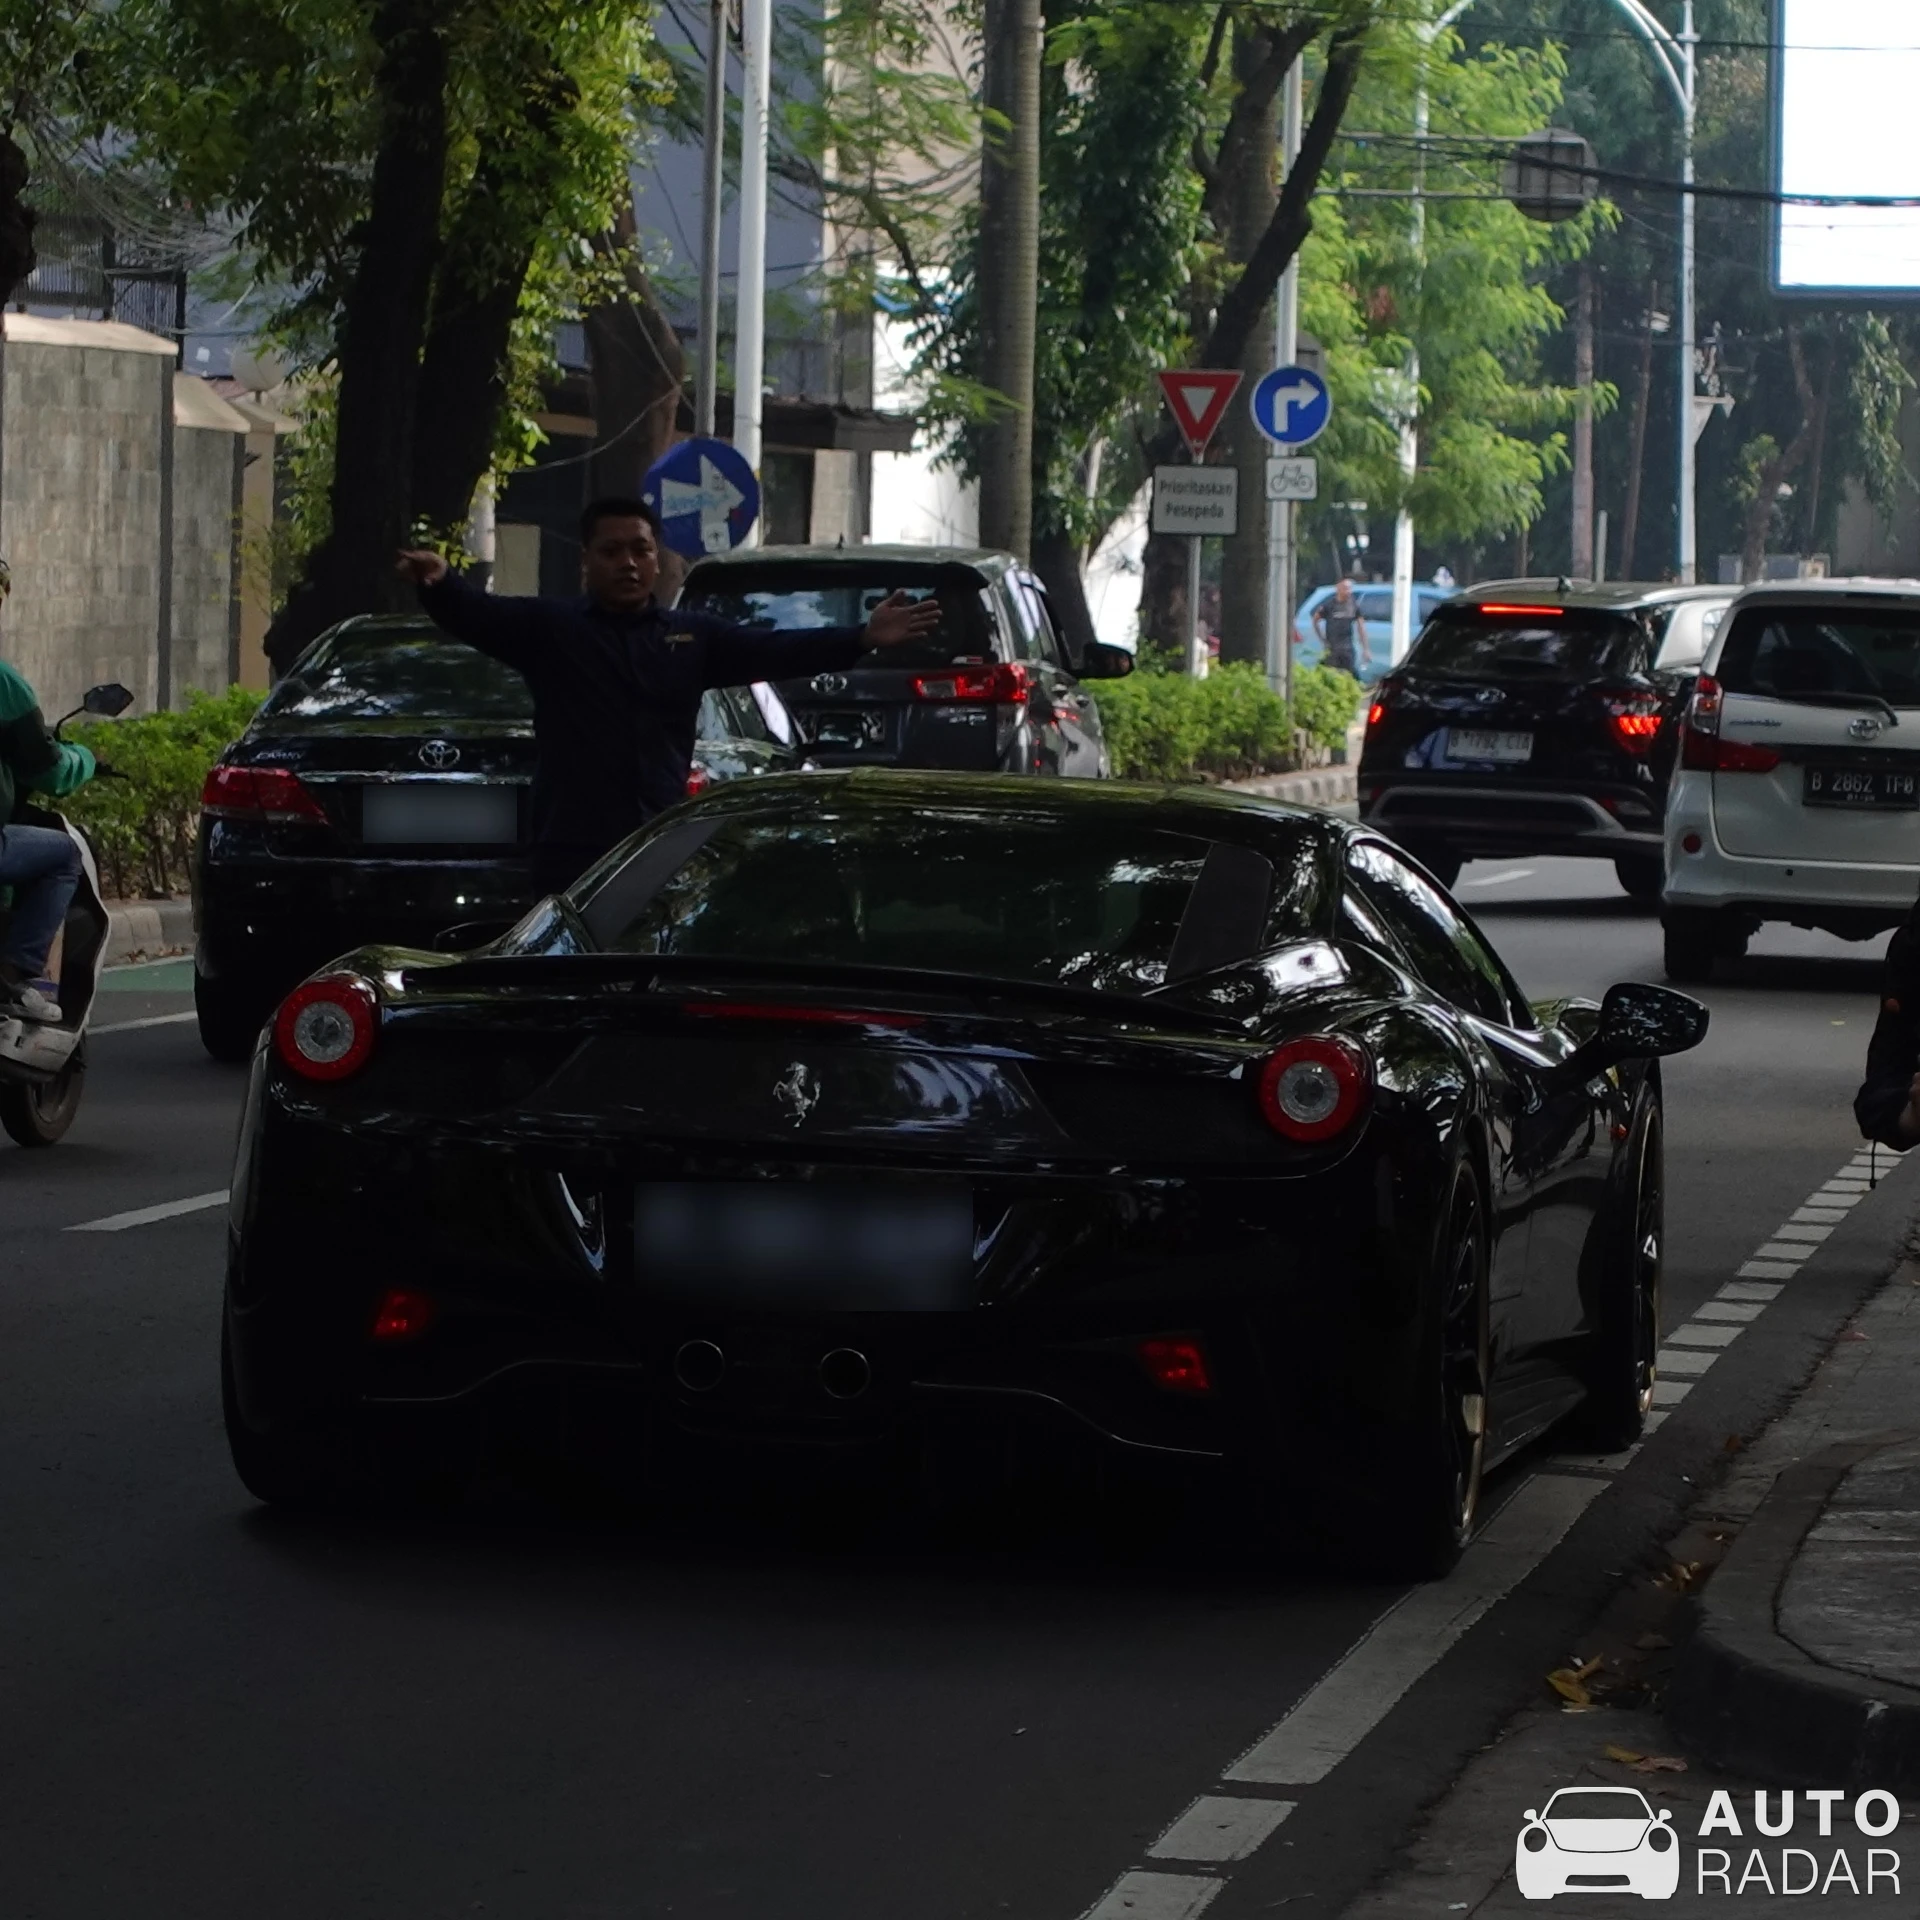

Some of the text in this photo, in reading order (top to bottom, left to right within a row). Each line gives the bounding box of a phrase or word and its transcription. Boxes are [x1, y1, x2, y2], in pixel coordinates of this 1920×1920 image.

[1160, 479, 1233, 496] Prioritaskan
[1166, 501, 1225, 520] Pesepeda
[1812, 771, 1823, 791] B
[1832, 772, 1874, 793] 2862
